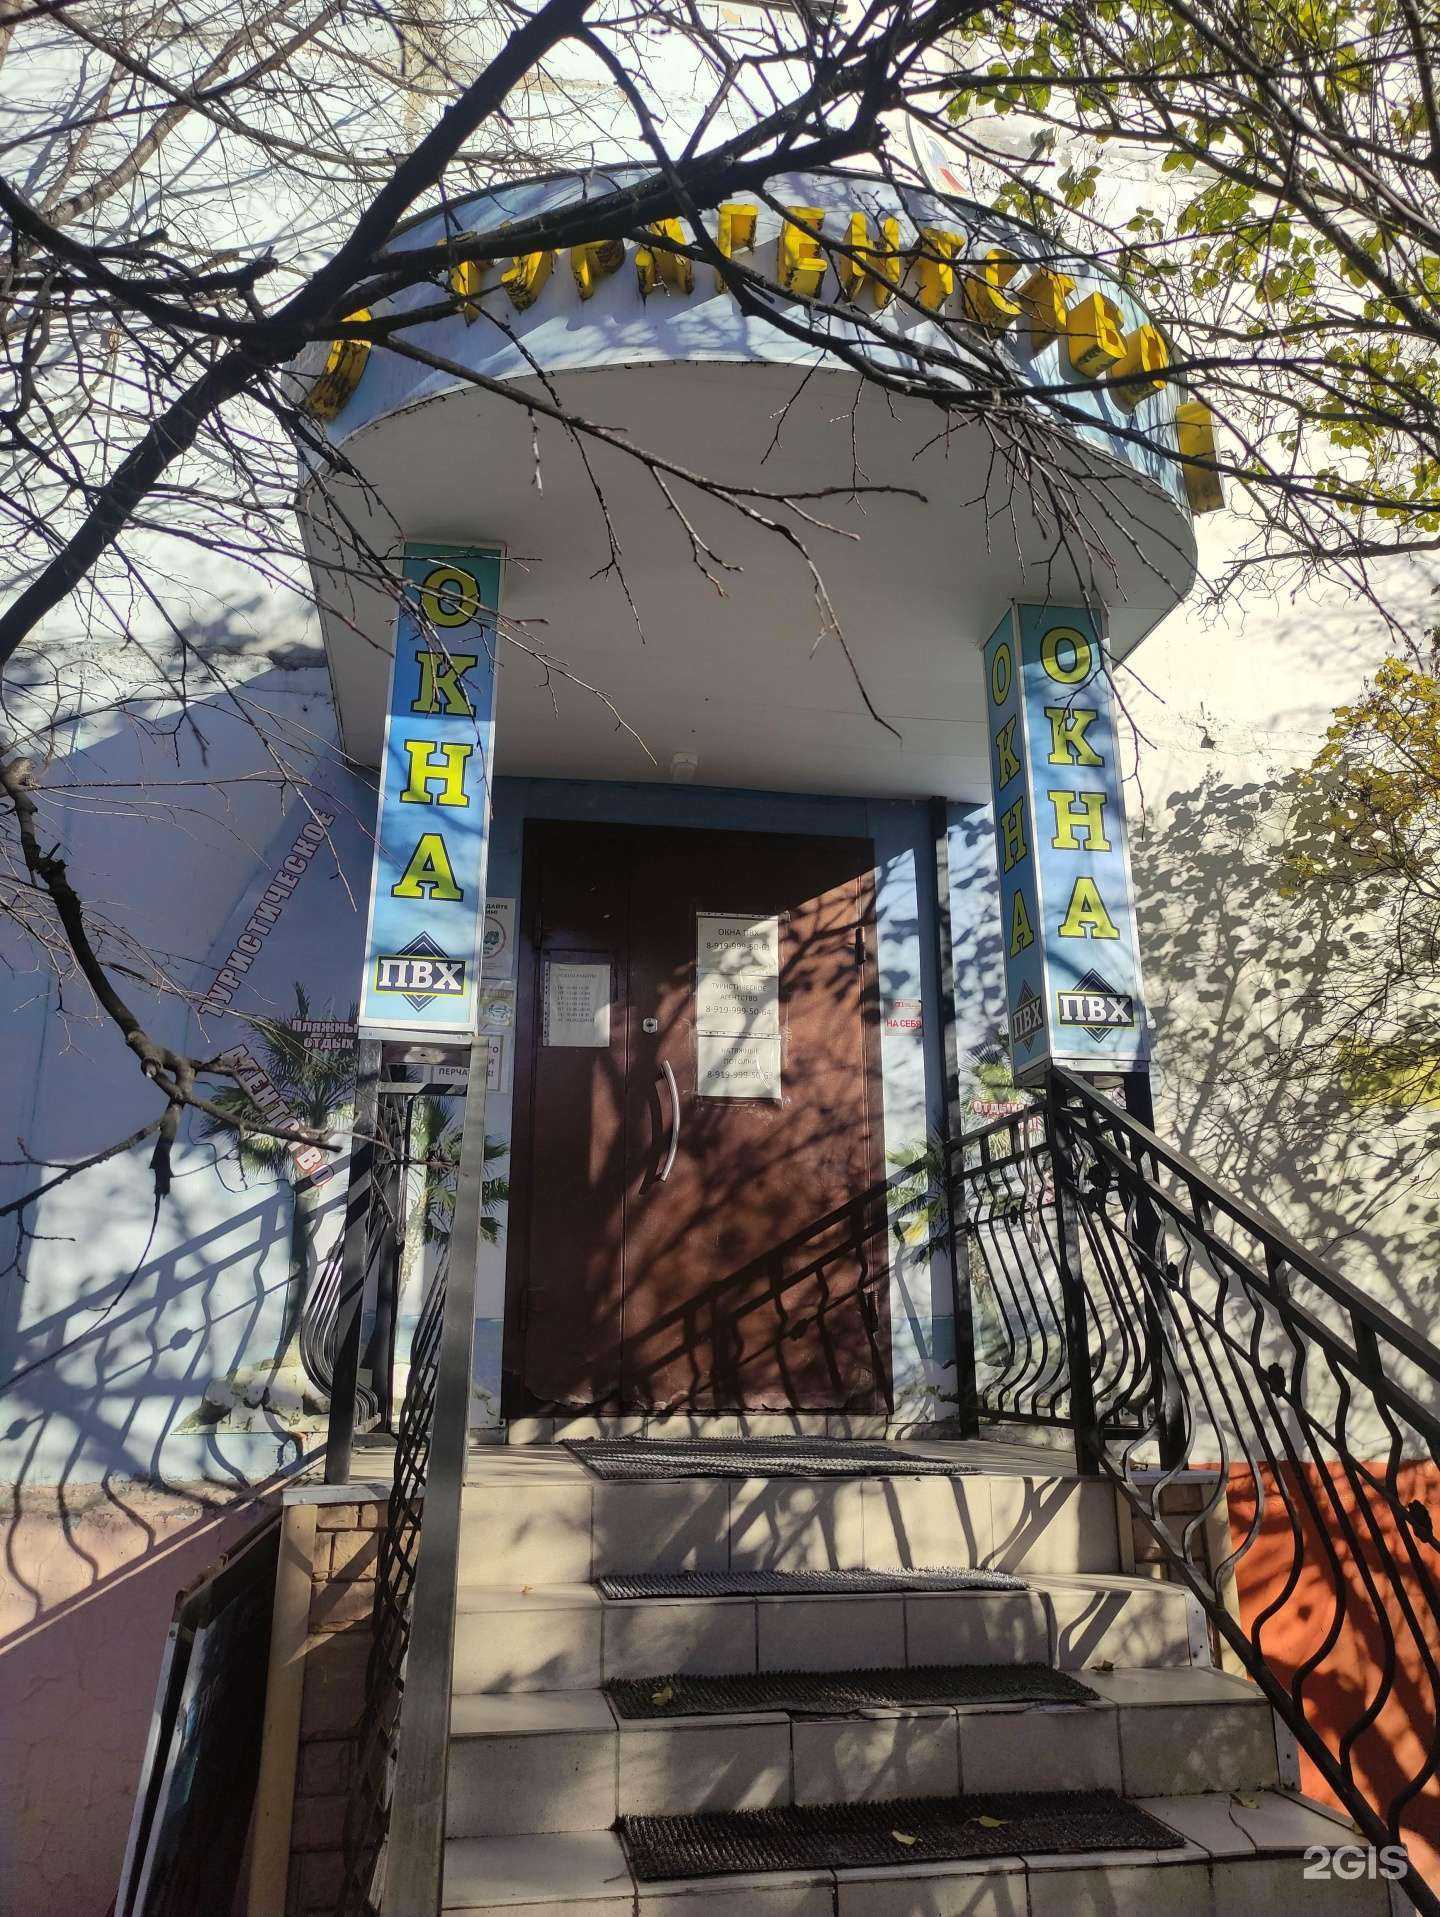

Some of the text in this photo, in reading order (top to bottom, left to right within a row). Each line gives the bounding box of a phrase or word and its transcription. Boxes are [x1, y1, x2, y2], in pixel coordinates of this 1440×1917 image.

[391, 566, 480, 901] ОКНА
[992, 643, 1034, 958] ОКНА
[1040, 626, 1120, 940] ОКНА
[199, 808, 336, 1018] ТУРИСТИЧЕСКОЕ
[718, 929, 740, 937] ОКНА
[378, 959, 464, 992] ПВХ
[887, 1019, 899, 1028] НА
[1012, 999, 1044, 1038] ПВХ
[1060, 995, 1132, 1023] ПВХ
[439, 1067, 470, 1076] ПЕРЧА
[221, 1044, 334, 1186] АГЕНТСВО
